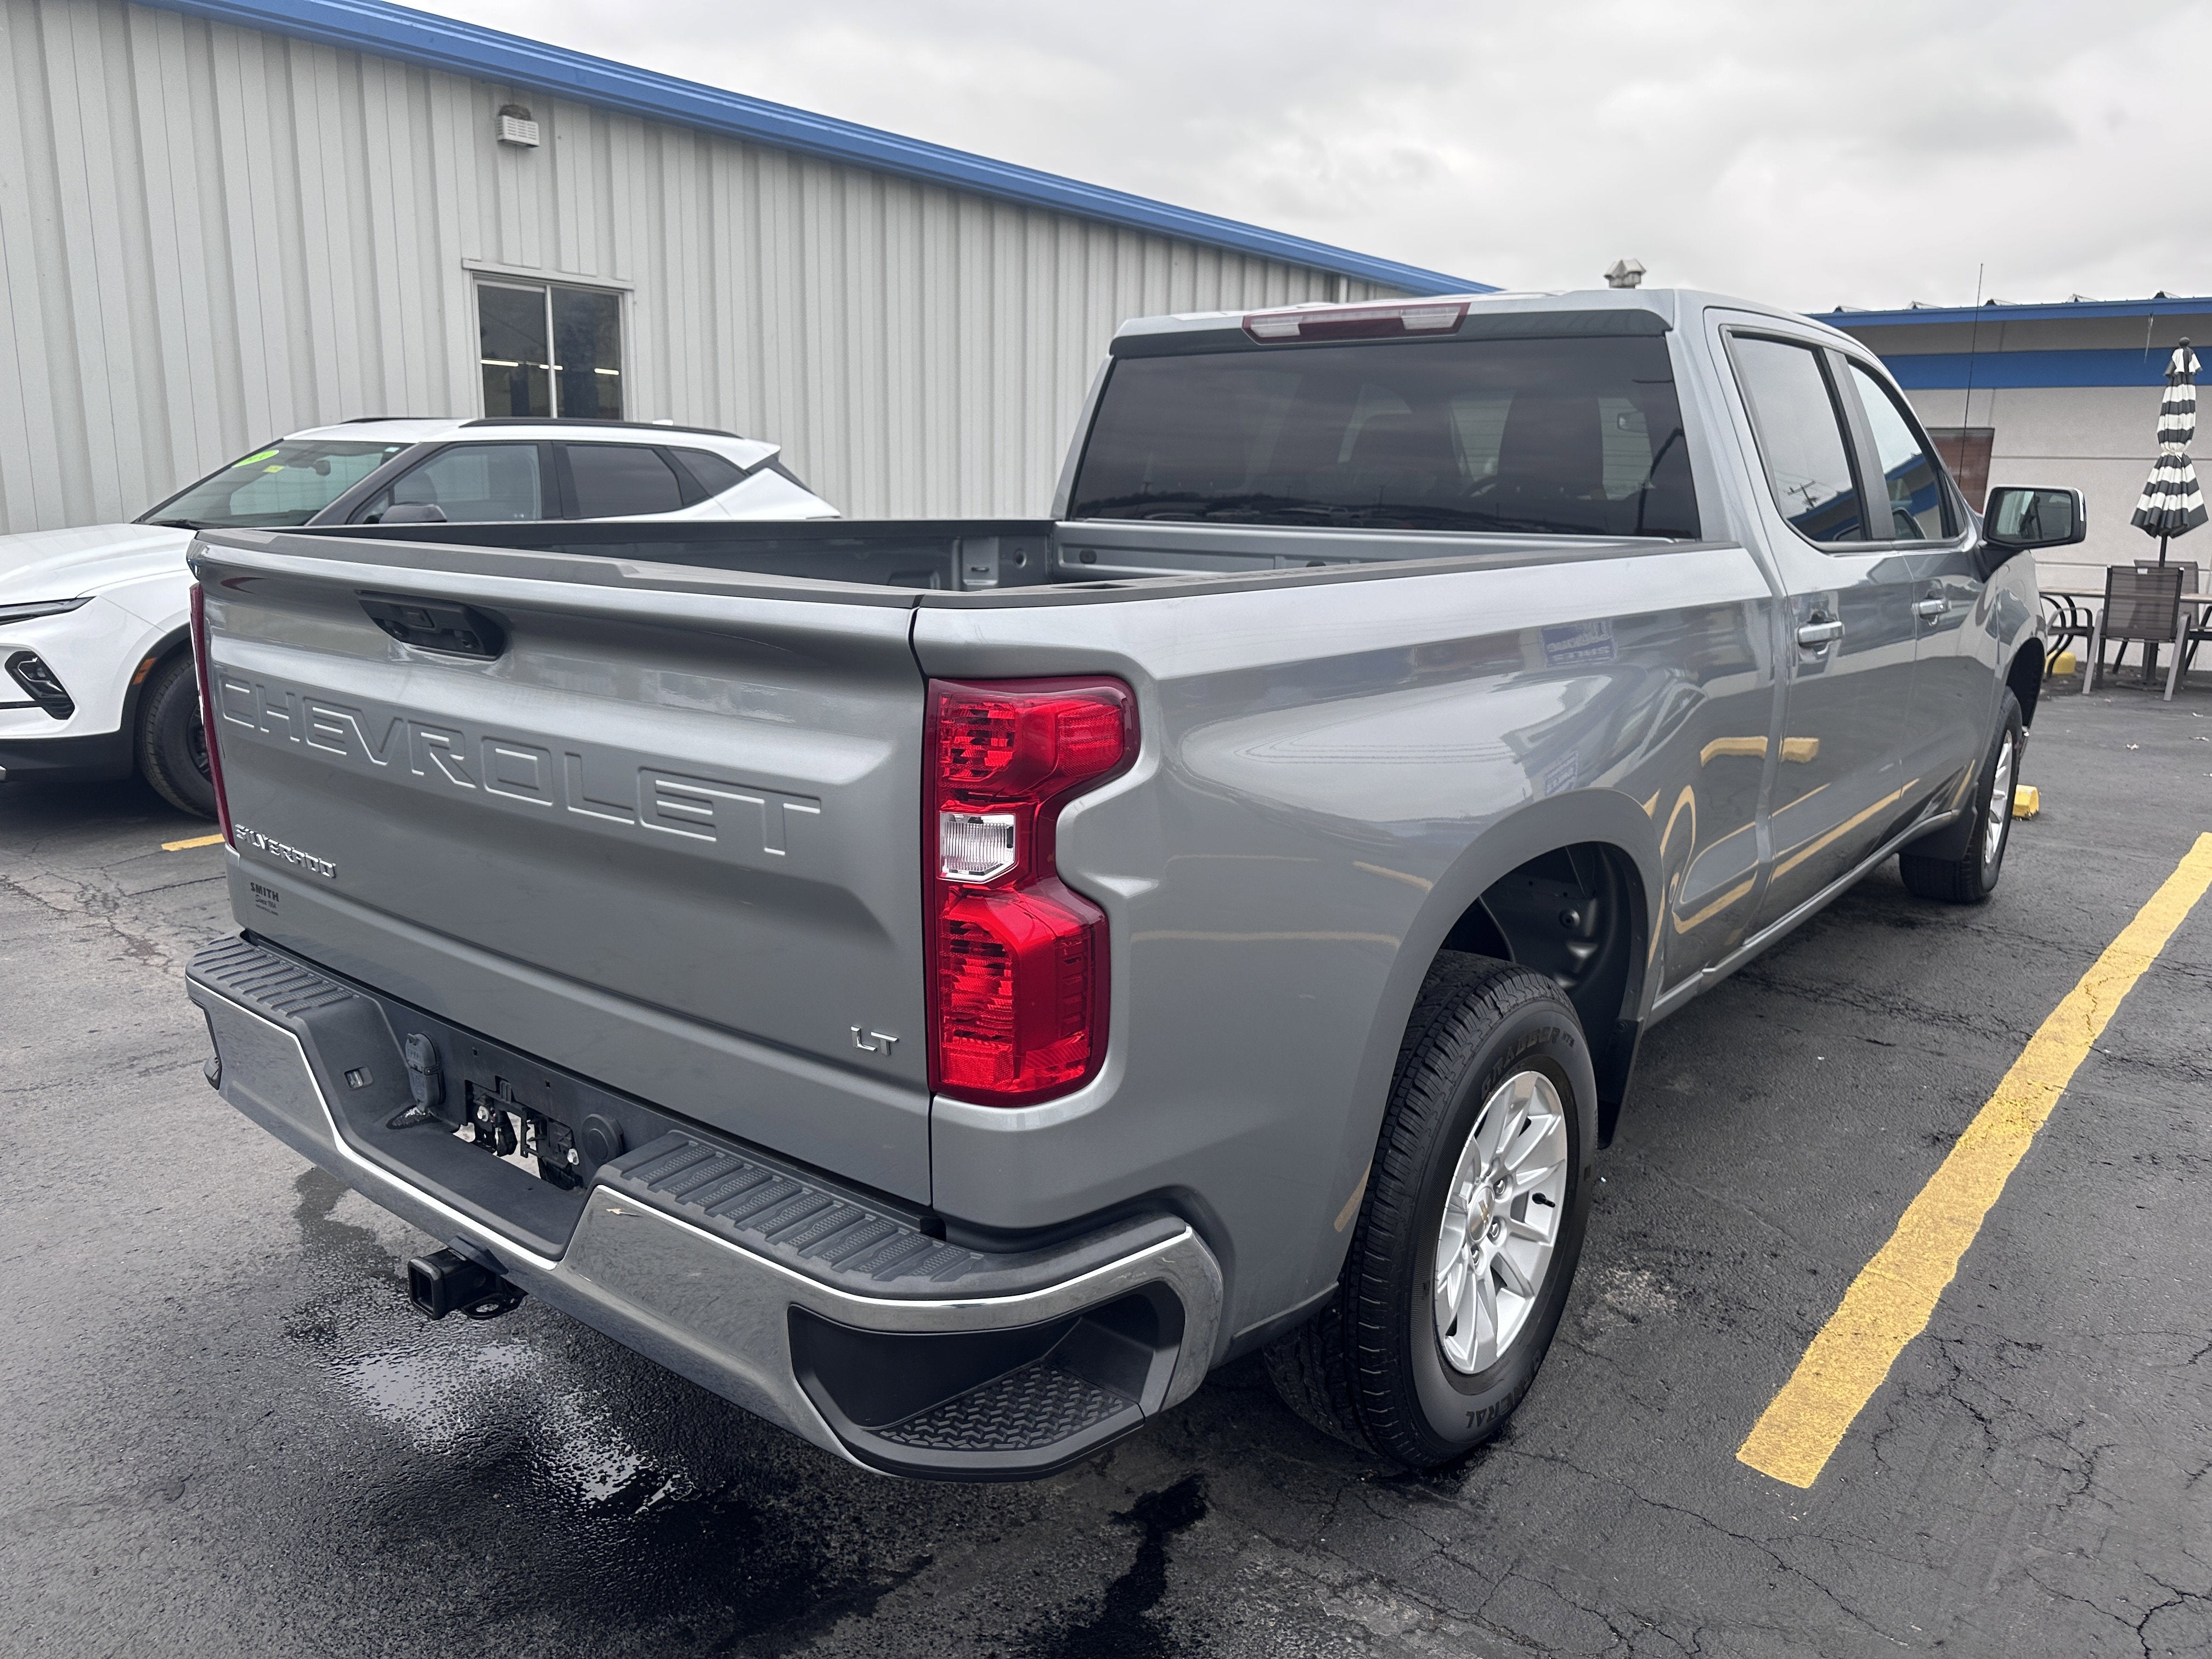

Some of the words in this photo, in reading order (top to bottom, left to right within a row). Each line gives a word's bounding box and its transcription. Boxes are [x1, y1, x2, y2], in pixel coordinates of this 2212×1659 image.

[219, 675, 822, 856] CHEVROLET
[235, 823, 336, 878] SILVERADO
[250, 882, 280, 902] SMITH
[851, 1026, 899, 1056] LT
[1481, 1026, 1561, 1100] GRABBER
